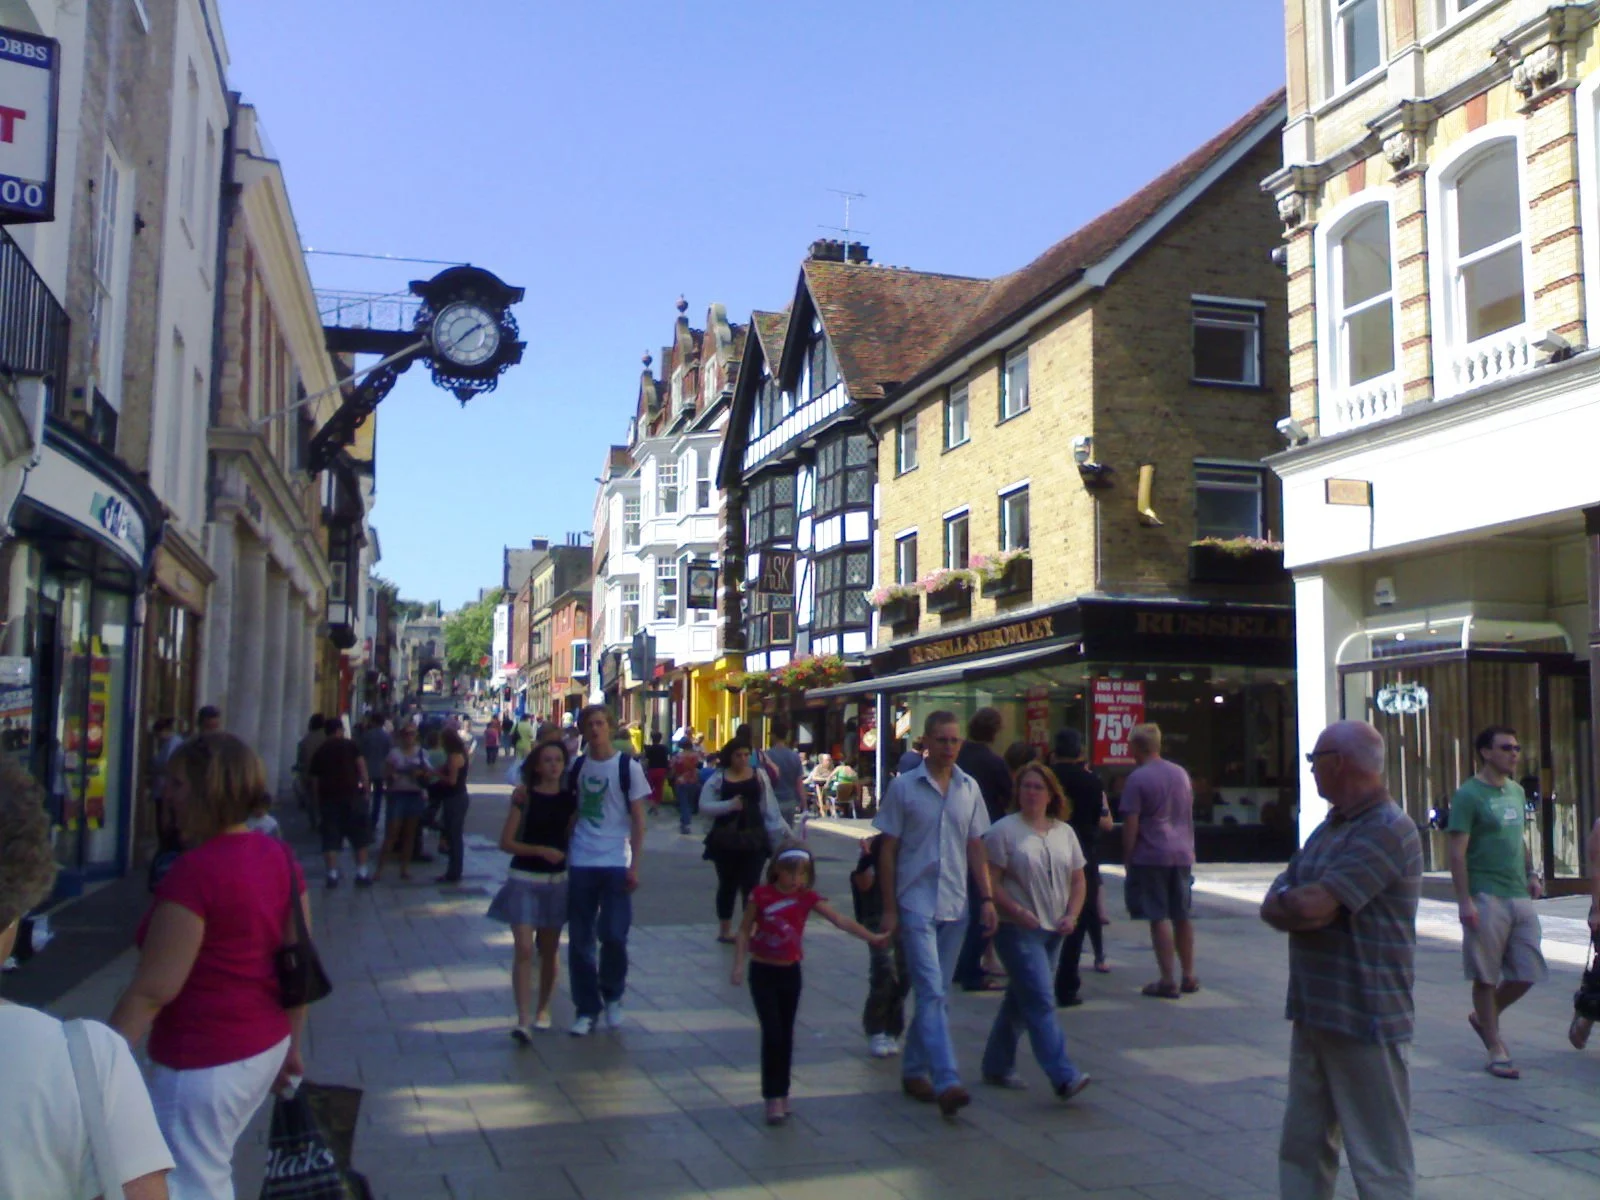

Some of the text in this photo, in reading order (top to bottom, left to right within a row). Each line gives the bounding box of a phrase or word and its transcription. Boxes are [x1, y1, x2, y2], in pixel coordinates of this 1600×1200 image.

[763, 555, 791, 590] ASK
[909, 636, 963, 665] RUSSELL
[978, 616, 1055, 650] BROMLEY
[1097, 681, 1140, 692] END OF SALE
[1094, 713, 1138, 742] 75%
[1110, 742, 1129, 757] OFF
